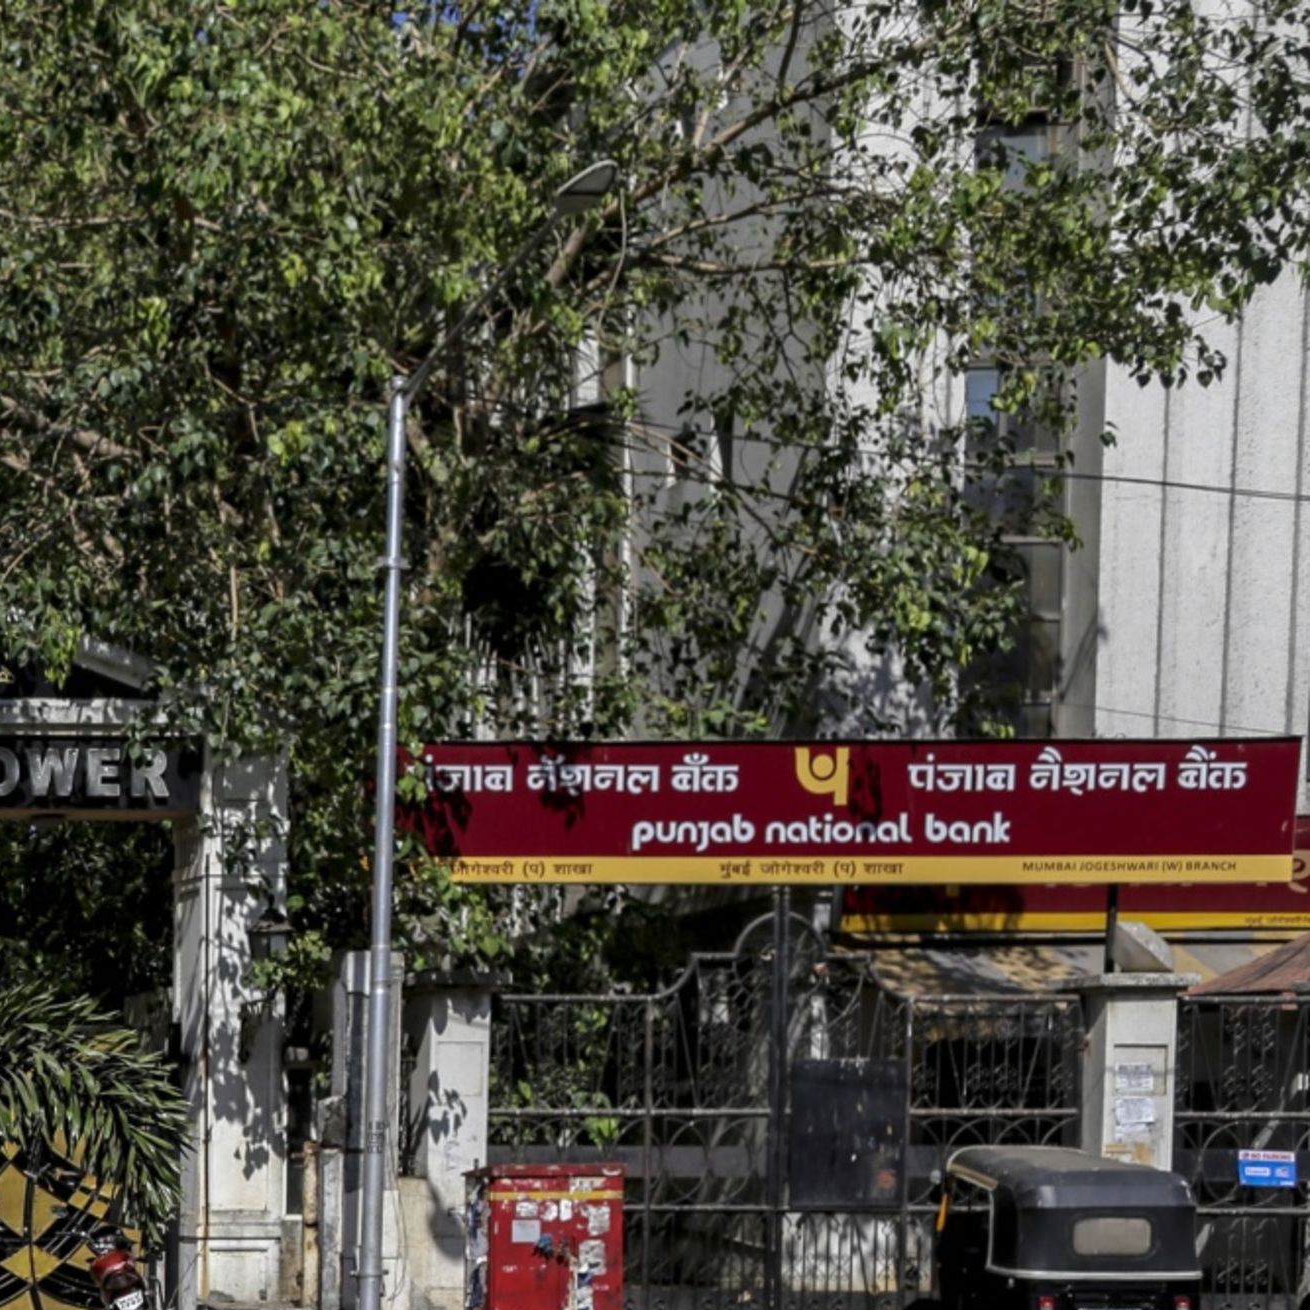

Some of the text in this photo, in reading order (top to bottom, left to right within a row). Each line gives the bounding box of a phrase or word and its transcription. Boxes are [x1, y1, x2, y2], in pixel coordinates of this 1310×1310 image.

[908, 745, 1248, 796] पंजाब नैशनल बैंक
[632, 812, 1010, 852] punjab national bank
[523, 861, 545, 877] (प)
[554, 861, 592, 876] शाखा
[720, 860, 751, 878] मुंबई
[833, 861, 856, 877] (प)
[865, 861, 903, 876] शाखा
[1022, 860, 1236, 873] MUMBAI JOGESHWARI (W) BRANCH
